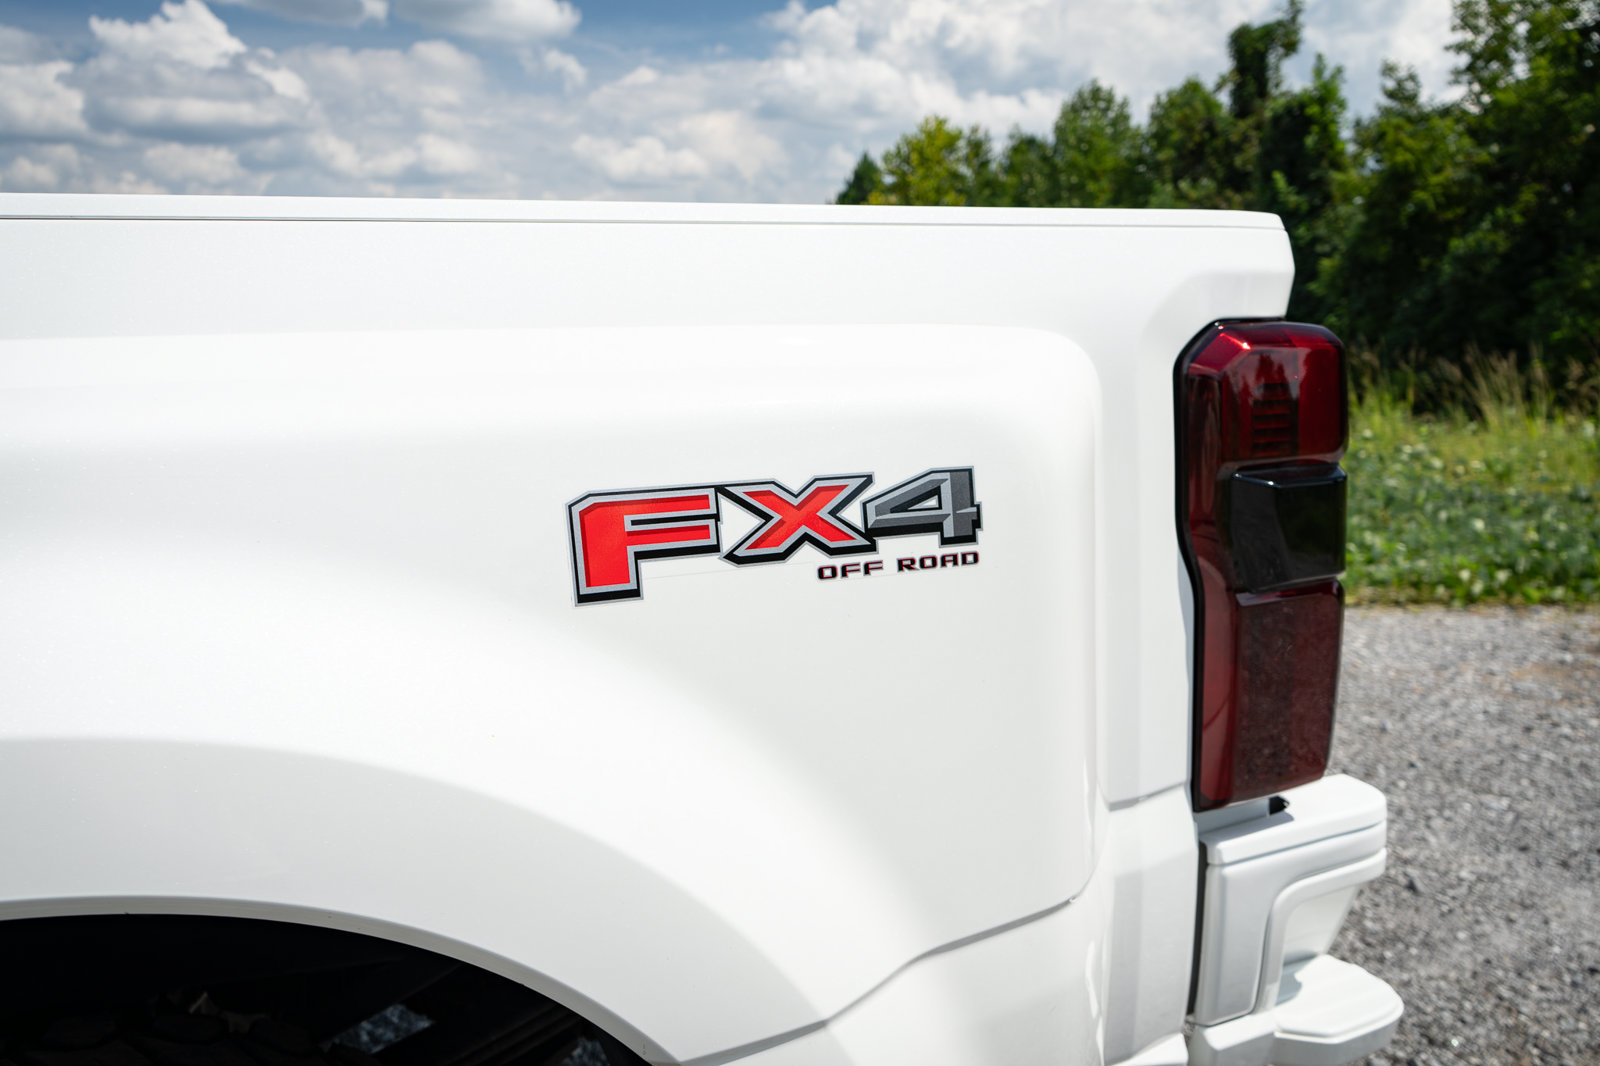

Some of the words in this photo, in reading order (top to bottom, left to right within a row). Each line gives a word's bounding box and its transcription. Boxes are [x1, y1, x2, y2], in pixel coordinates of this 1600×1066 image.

[566, 466, 983, 606] FX4
[817, 560, 884, 580] OFF
[896, 551, 979, 573] ROAD
